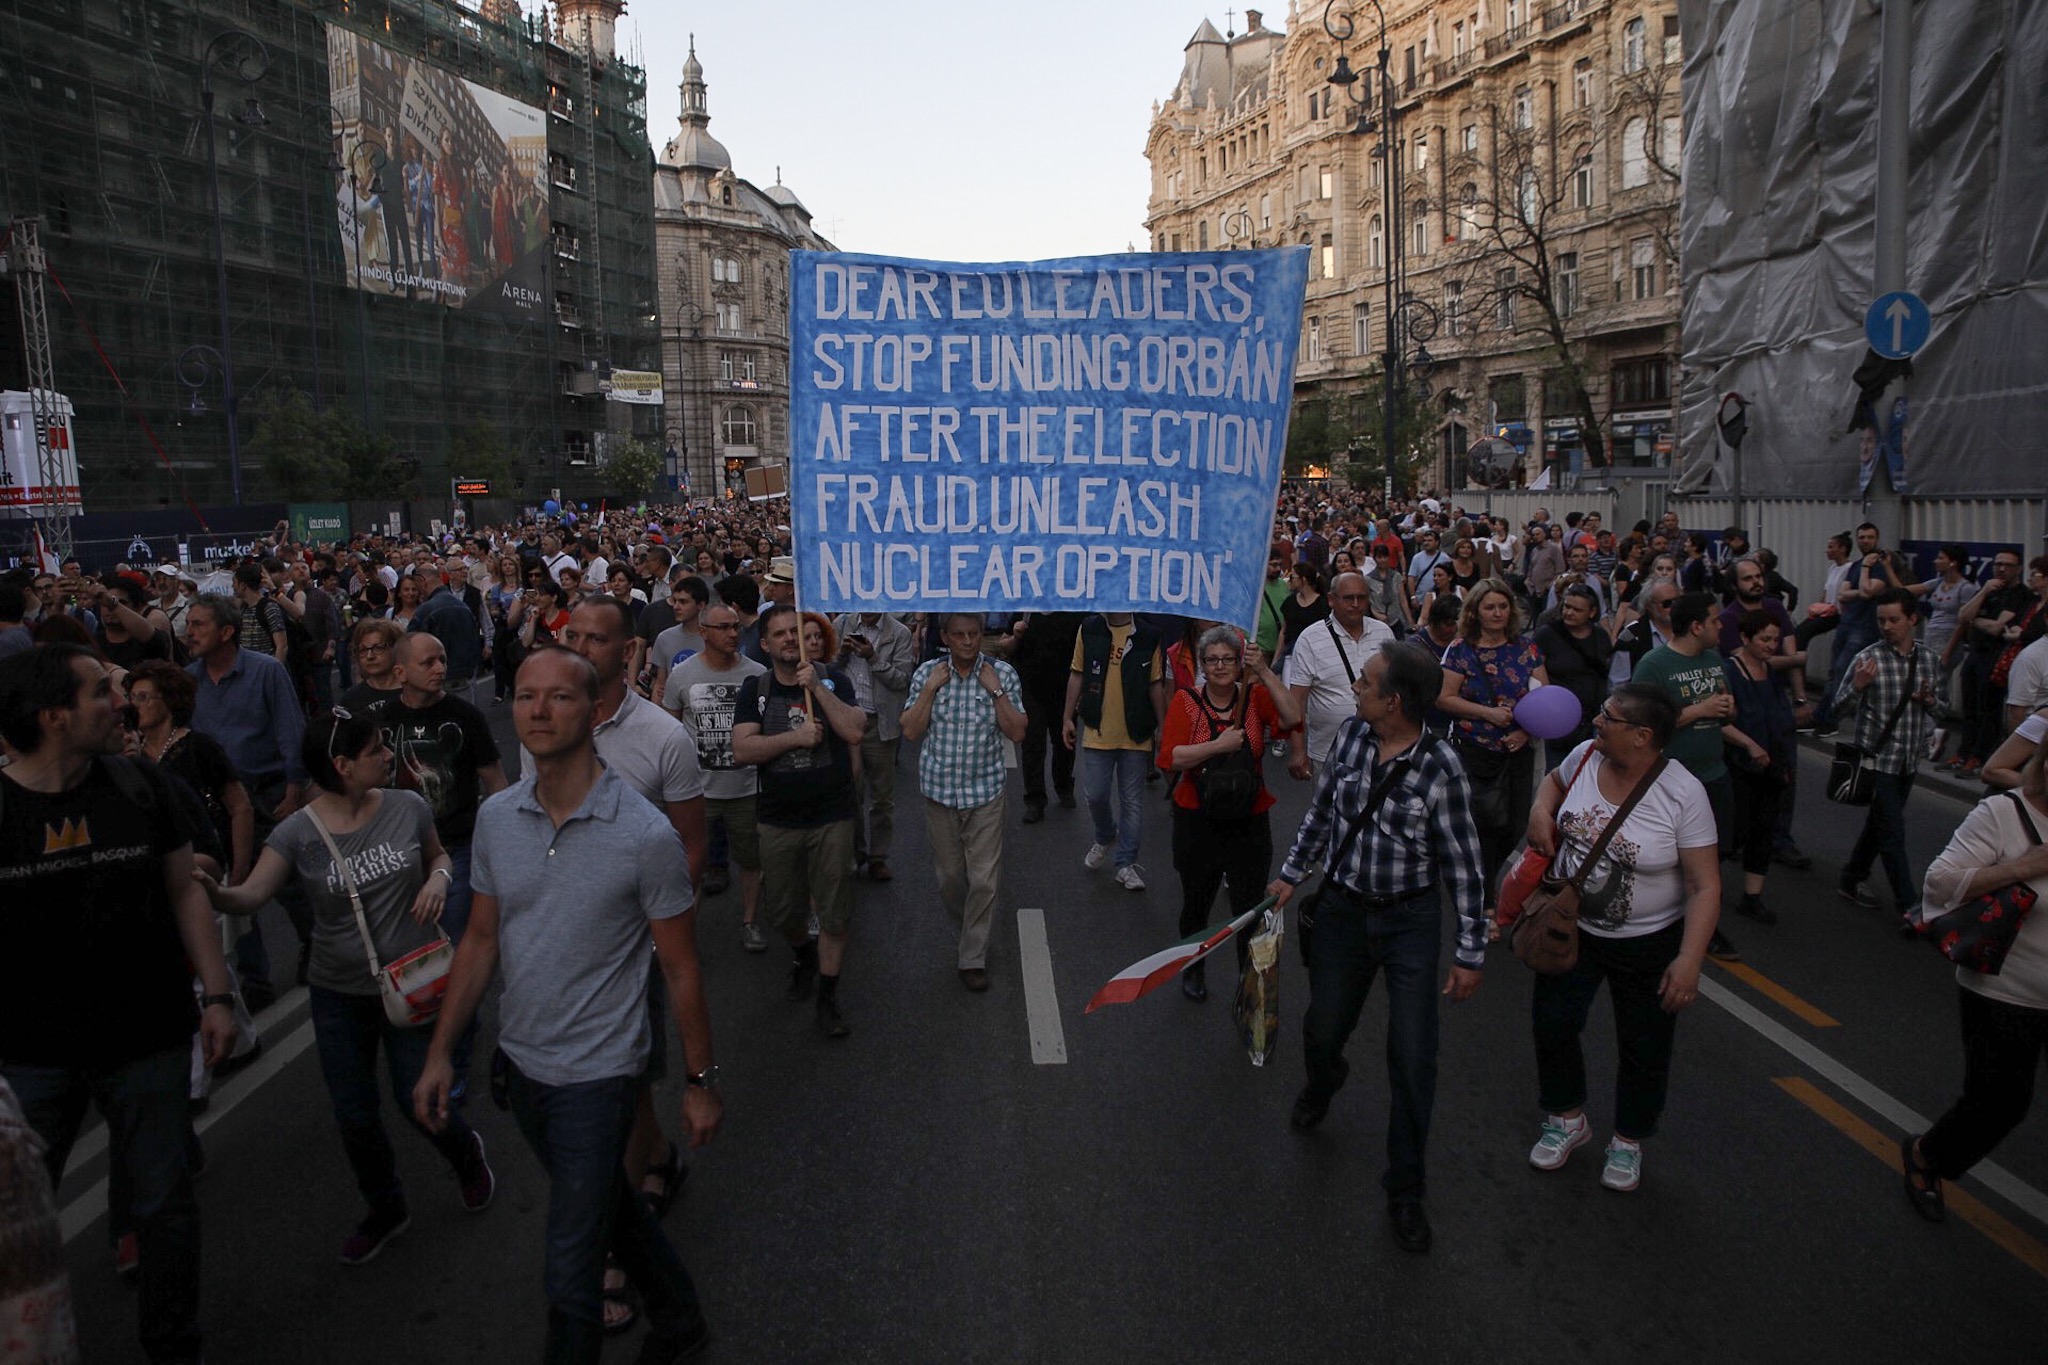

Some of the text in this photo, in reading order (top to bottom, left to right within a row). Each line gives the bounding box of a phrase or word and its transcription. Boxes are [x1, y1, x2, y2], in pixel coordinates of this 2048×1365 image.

[353, 264, 467, 297] MINDIG ÚJAT MUTATUNK
[502, 281, 542, 304] ARENA
[816, 264, 1264, 334] DEAR EU LEADERS,
[813, 334, 932, 392] STOP
[941, 334, 1131, 393] FUNDING
[815, 402, 1273, 479] AFTER THE ELECTION
[991, 476, 1200, 541] UNLEASH
[819, 542, 1044, 601] NUCLEAR
[1676, 668, 1703, 682] VALLEY
[330, 841, 397, 876] TOPICAL
